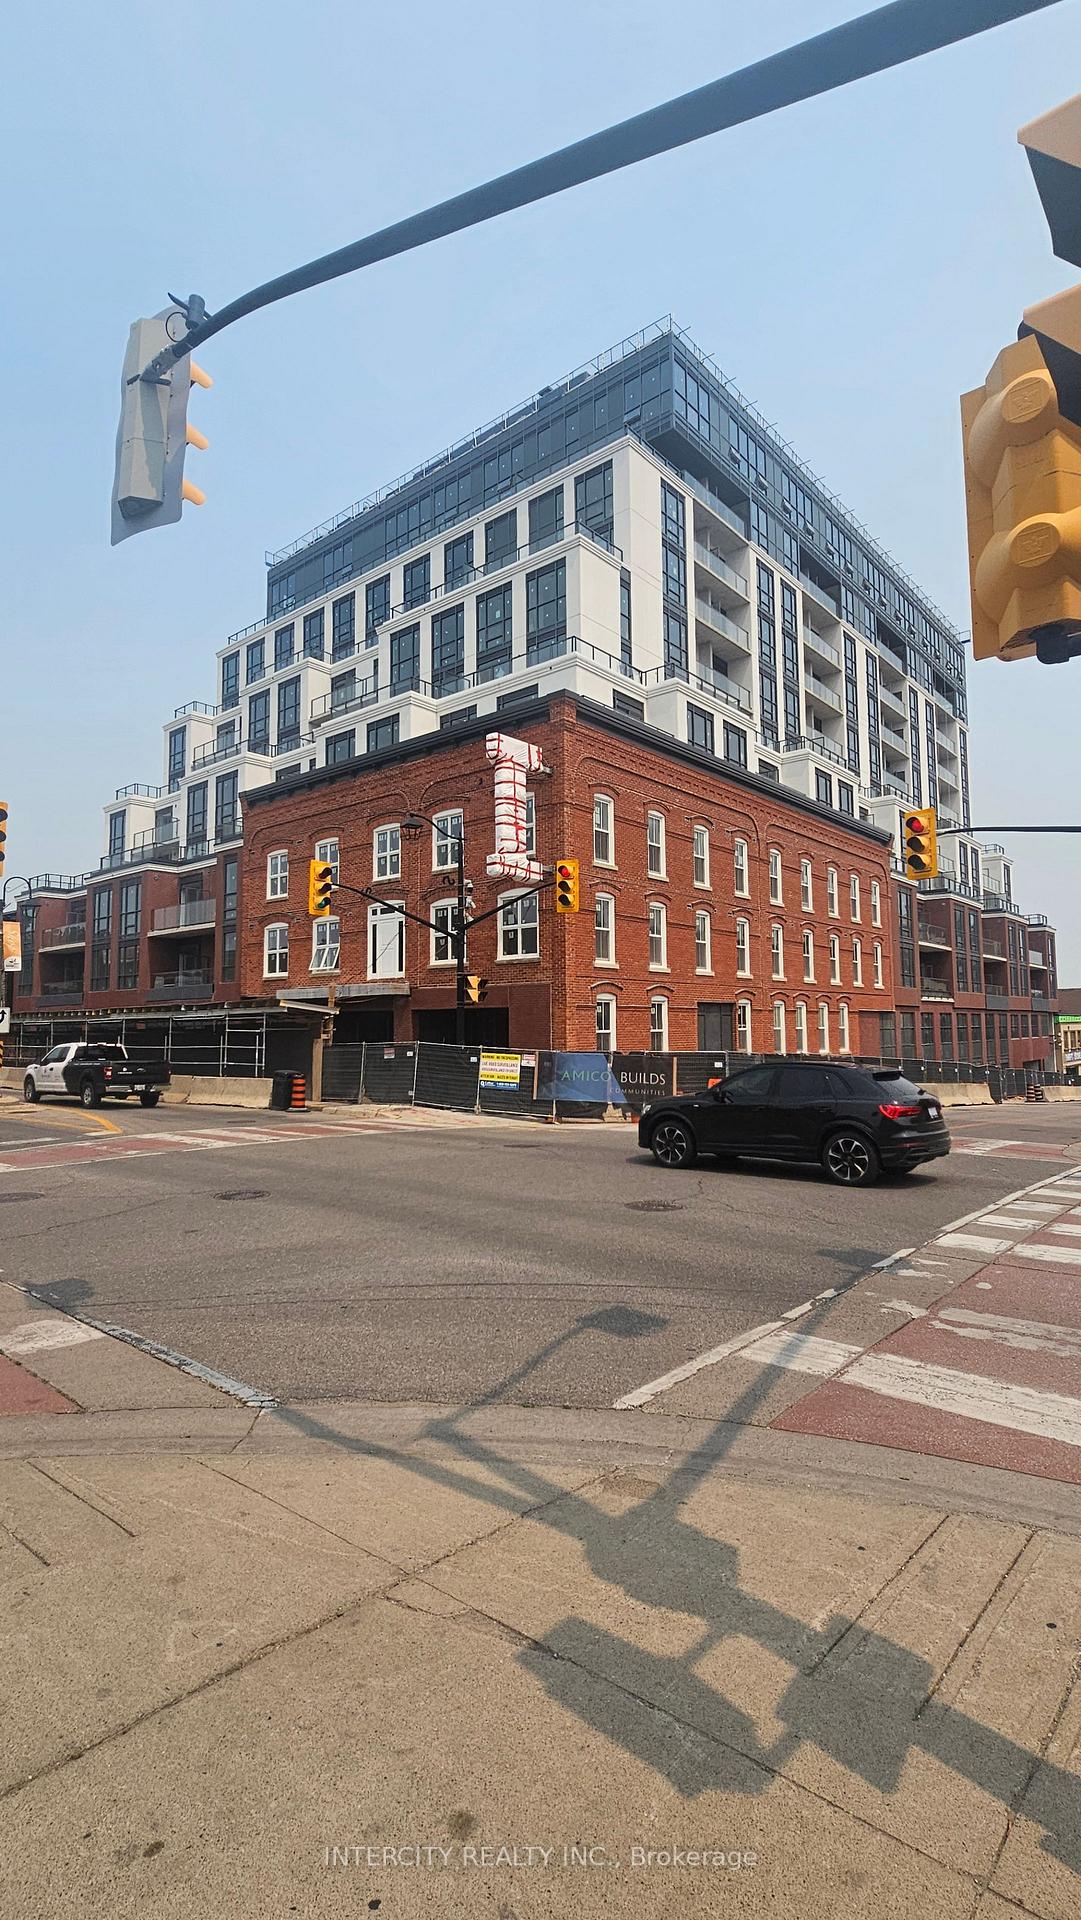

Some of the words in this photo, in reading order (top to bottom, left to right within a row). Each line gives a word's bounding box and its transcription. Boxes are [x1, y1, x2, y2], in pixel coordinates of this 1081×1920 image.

[561, 1070, 612, 1082] AMICO
[620, 1071, 666, 1085] BUILDS
[610, 1088, 666, 1096] COMMUNITIES
